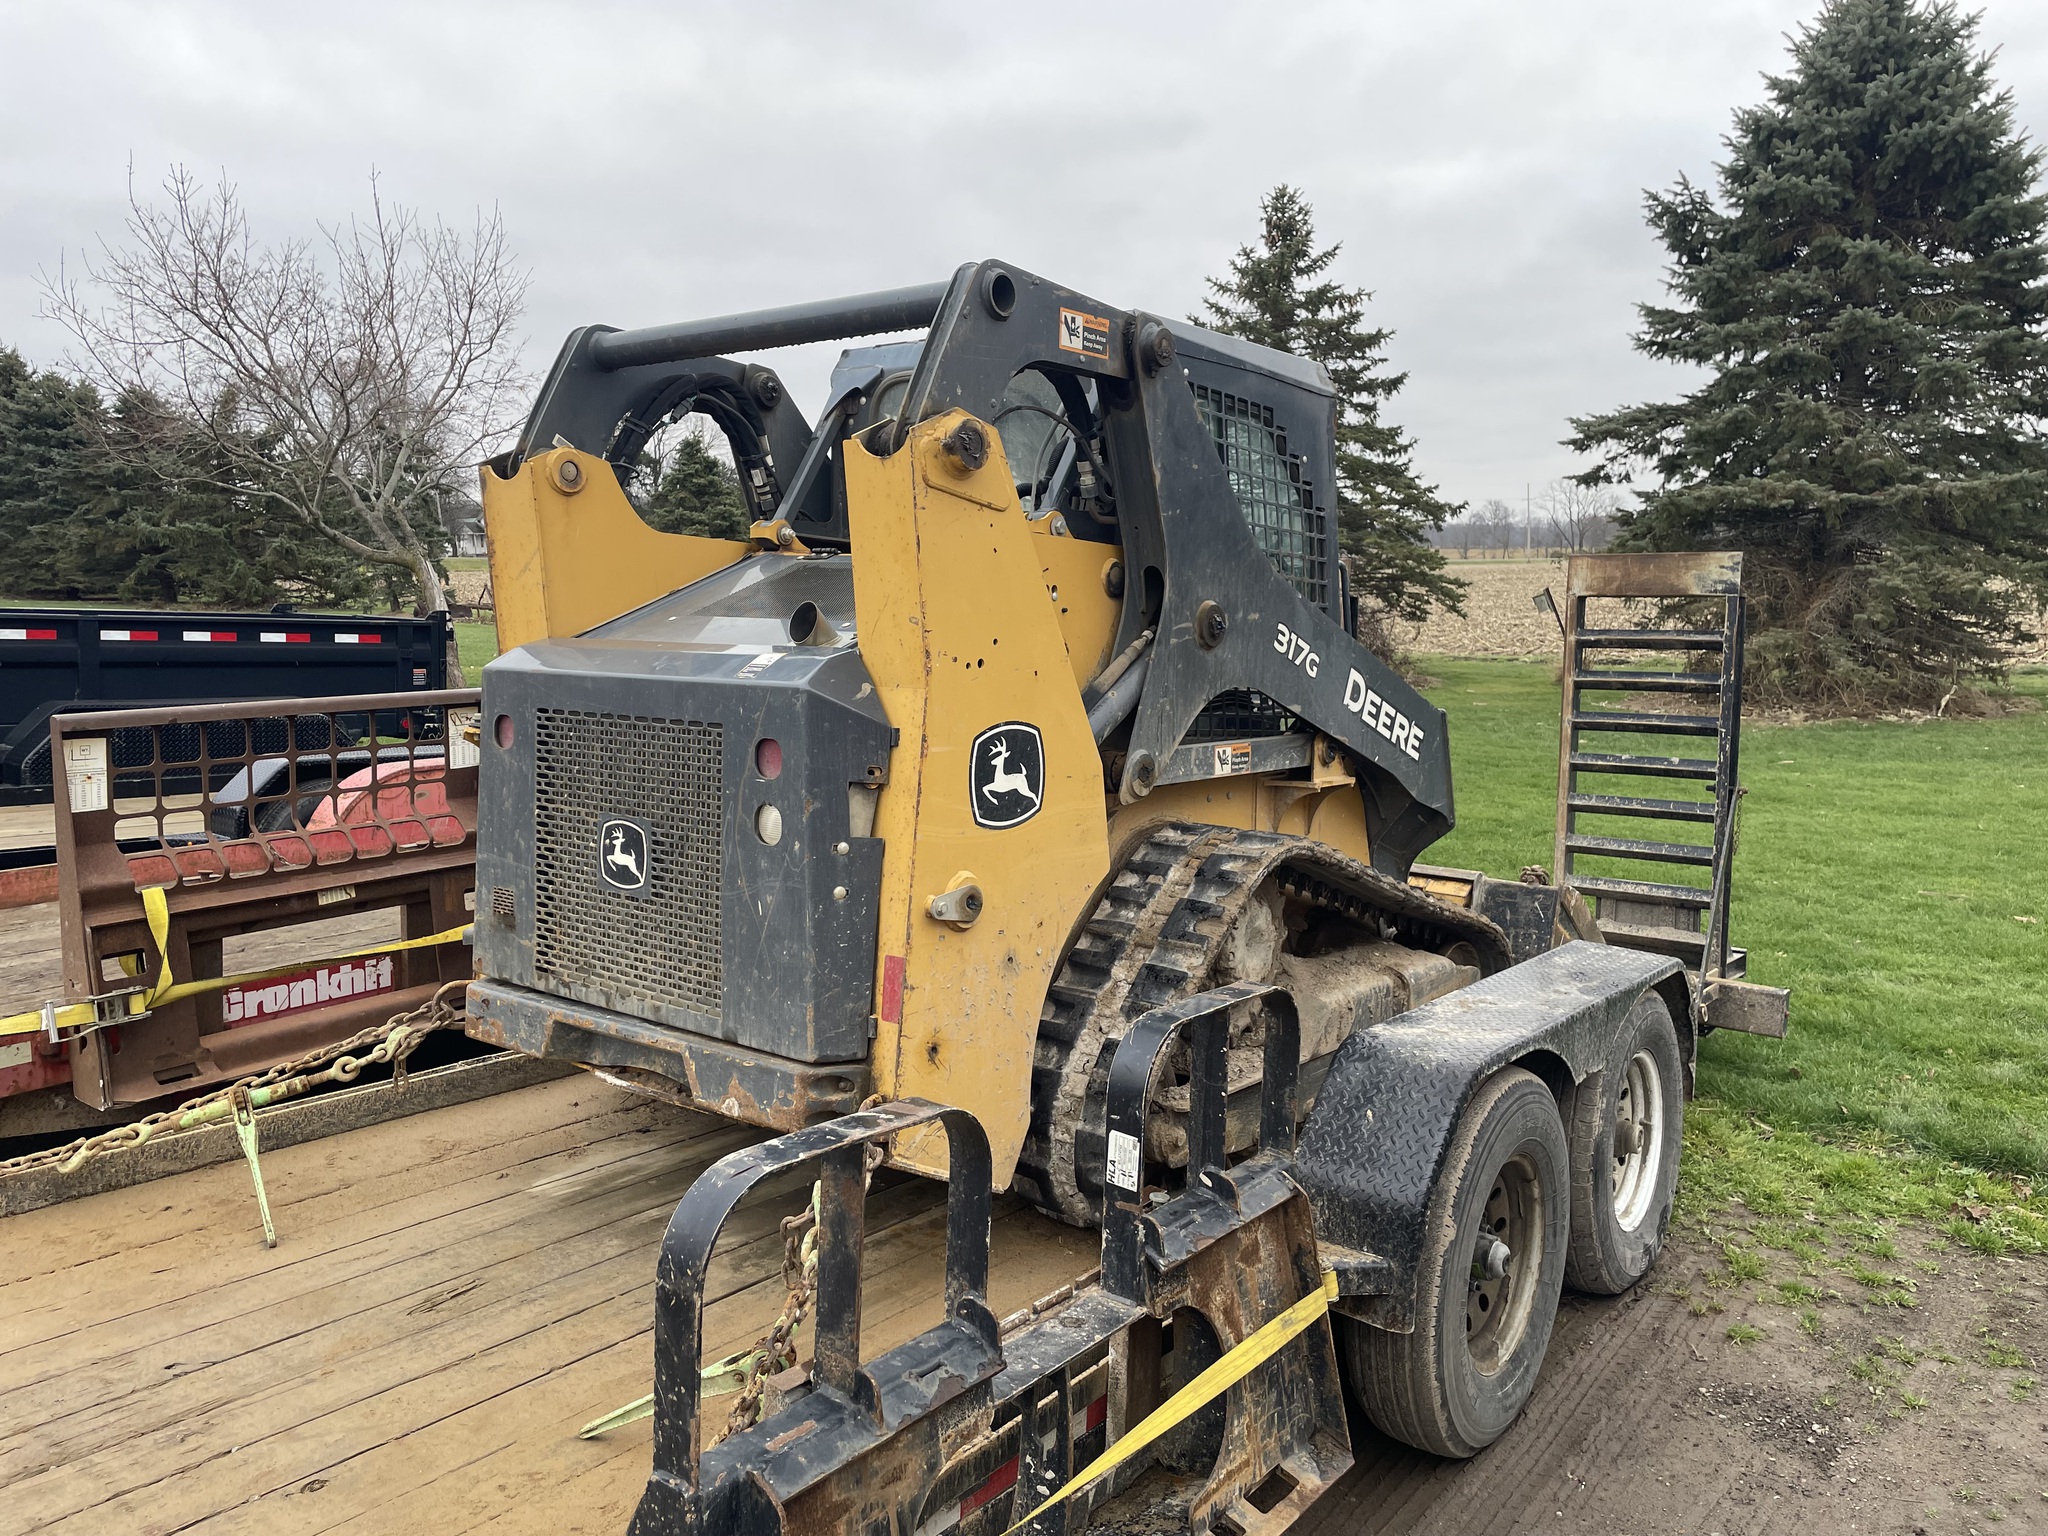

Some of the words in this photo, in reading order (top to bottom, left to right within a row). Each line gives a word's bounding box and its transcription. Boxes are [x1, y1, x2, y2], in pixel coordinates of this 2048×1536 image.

[1083, 340, 1093, 348] Keep
[1093, 343, 1103, 351] Away
[1084, 331, 1096, 341] Pinch
[1096, 334, 1107, 343] Area
[1274, 623, 1320, 678] 317G
[1343, 667, 1425, 762] DEERE
[1107, 1159, 1117, 1184] HLA
